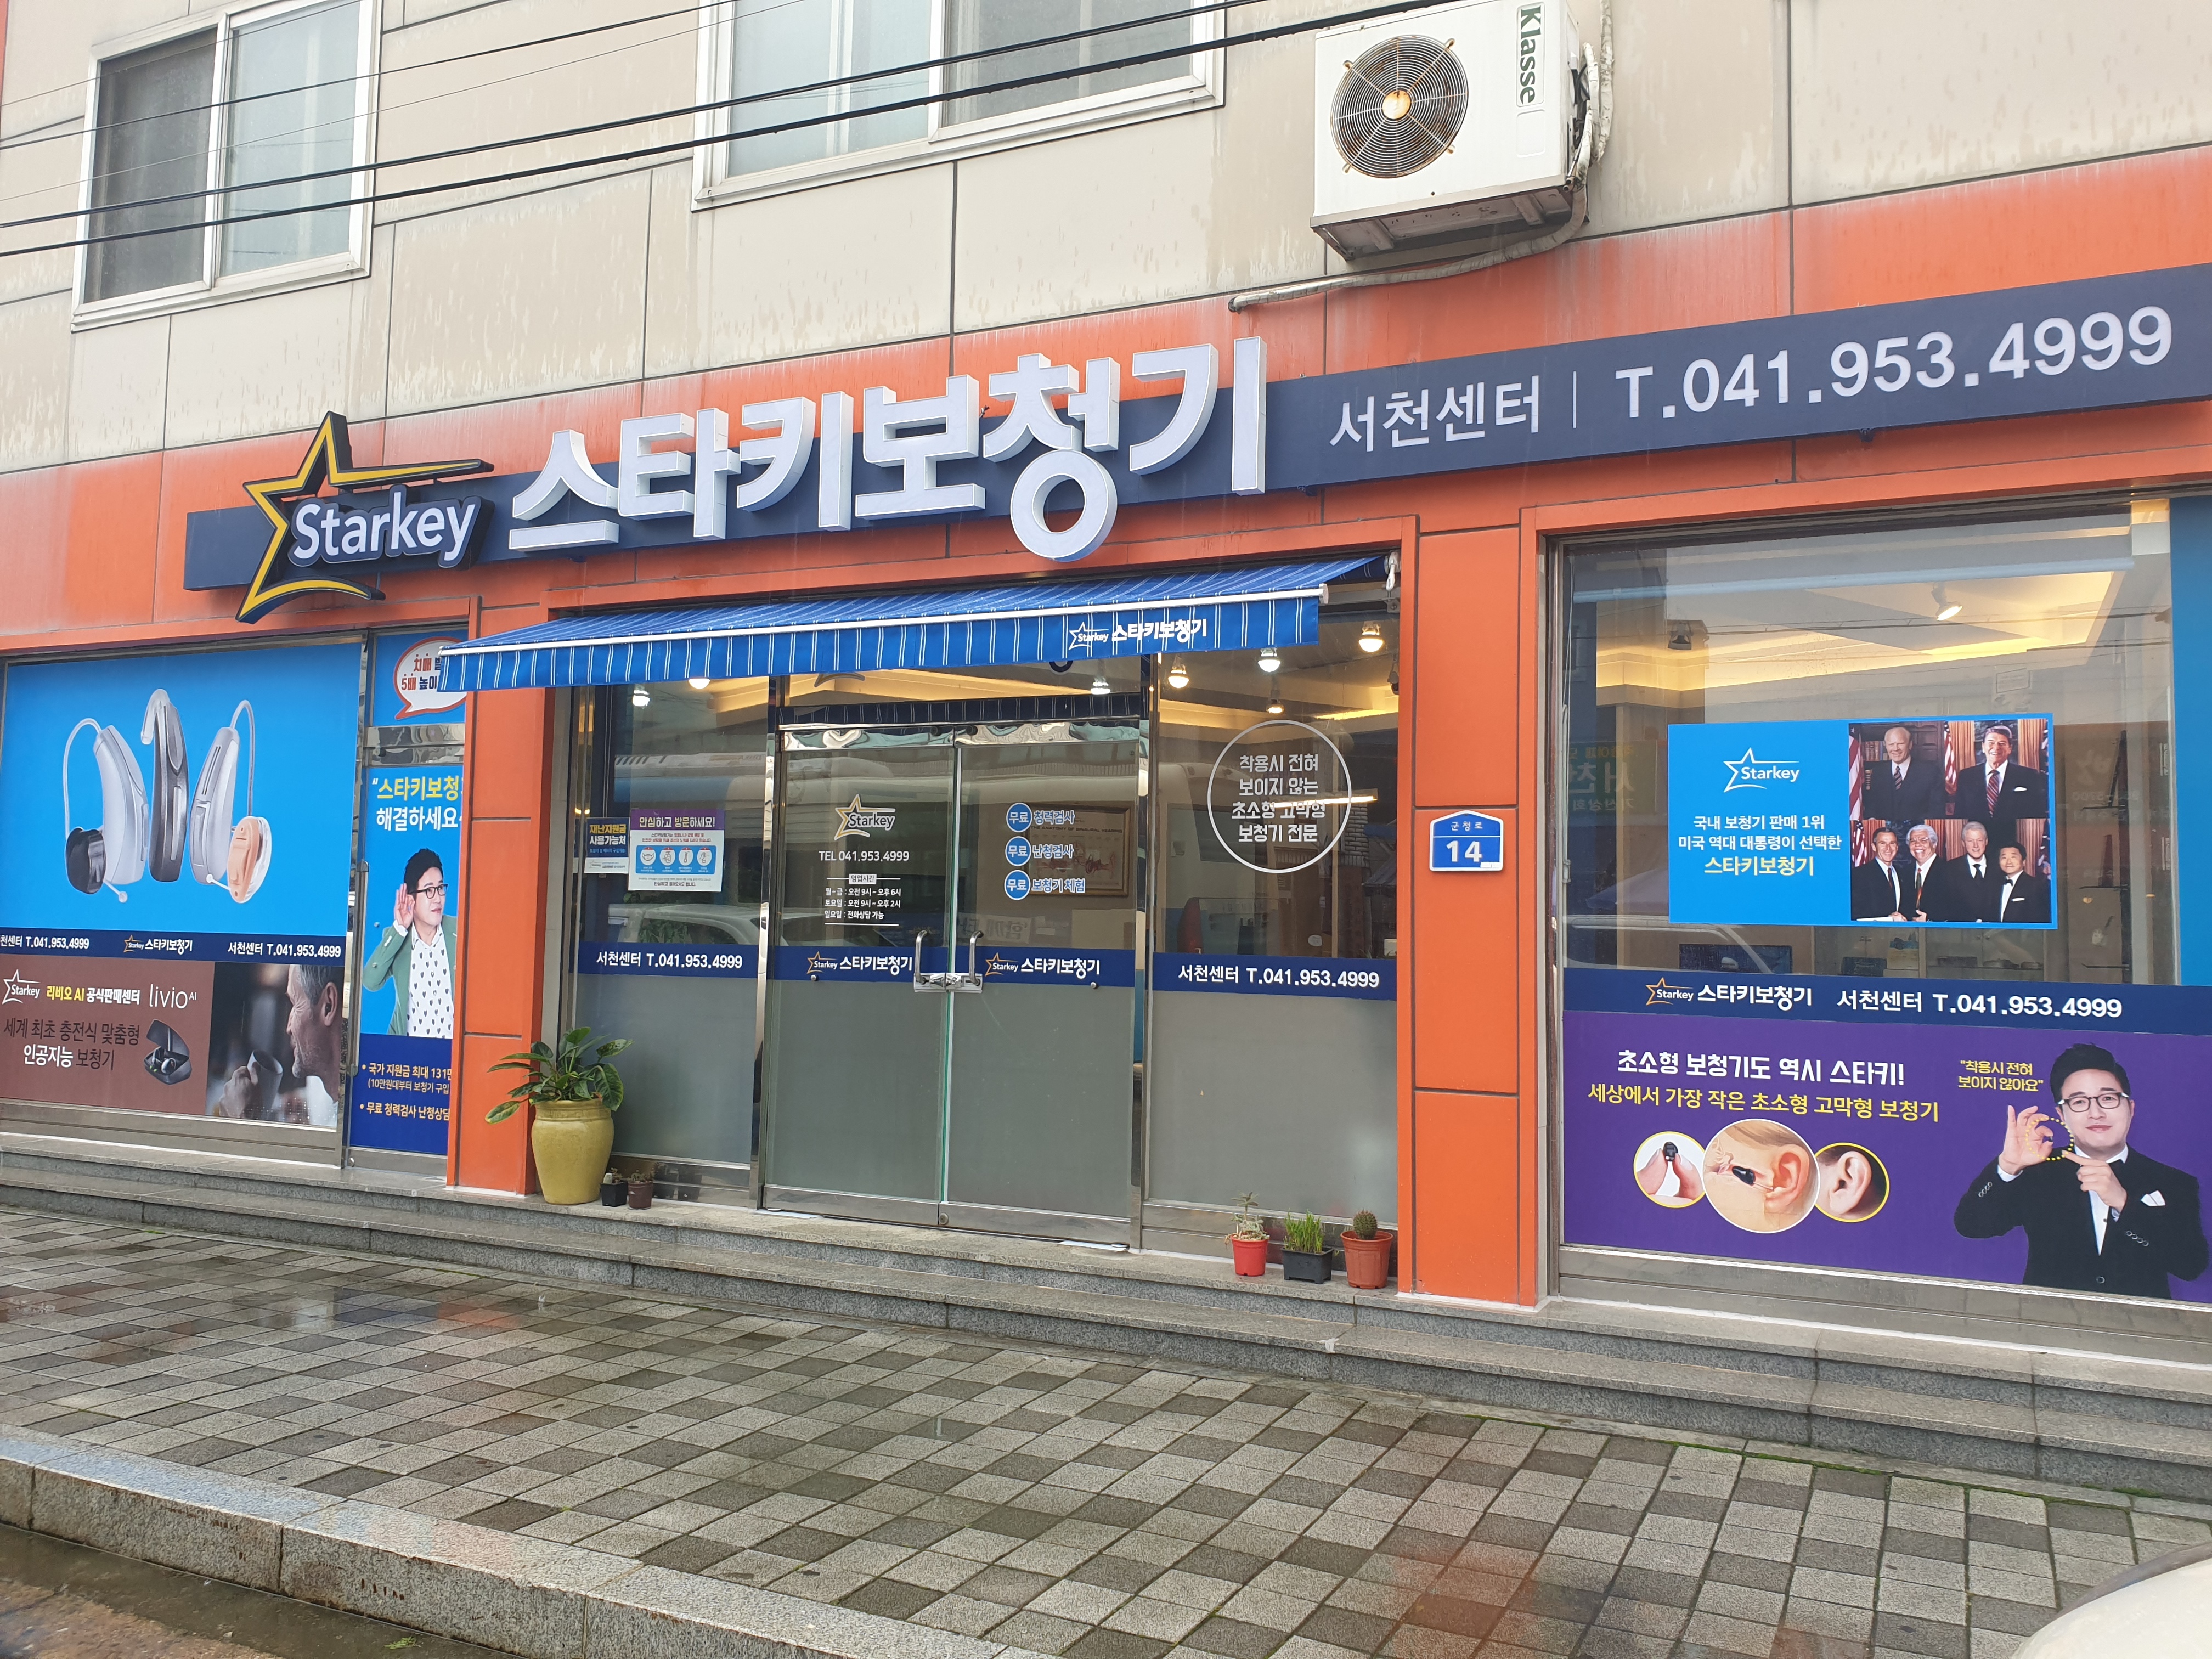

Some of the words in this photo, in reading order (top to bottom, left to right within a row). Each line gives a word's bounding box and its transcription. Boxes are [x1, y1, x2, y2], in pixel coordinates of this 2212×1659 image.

[1520, 6, 1542, 105] Klasse
[292, 485, 478, 568] Starkey
[509, 336, 1267, 562] 스타키보청기
[1329, 375, 1539, 452] 서천센터
[1616, 306, 2172, 419] T.041.953.4999
[1077, 632, 1109, 642] Starkey
[1111, 619, 1207, 643] 스타키보청기
[414, 657, 432, 672] 치매
[401, 677, 416, 691] 5배
[1240, 754, 1284, 772] 착용시
[1289, 753, 1318, 771] 전혀
[1741, 765, 1800, 782] Starkey
[1239, 778, 1283, 795] 보이지
[1289, 777, 1318, 795] 않는
[1008, 811, 1029, 824] 무료
[1034, 810, 1075, 825] 청력검사
[1232, 801, 1275, 819] 초소형
[589, 823, 627, 834] 재난지원금
[639, 816, 672, 828] 안심하고
[674, 816, 715, 828] 방문하세요!
[849, 813, 895, 830] Starkey
[1693, 816, 1720, 830] 국내
[1724, 815, 1765, 830] 보청기
[1769, 815, 1797, 830] 판매
[1802, 815, 1825, 830] 1위
[589, 835, 627, 845] 사용가능처
[1238, 824, 1282, 842] 보청기
[1288, 825, 1318, 842] 전문
[1678, 836, 1705, 850] 미국
[1708, 836, 1736, 850] 역대
[1740, 835, 1795, 850] 대통령이
[1799, 834, 1842, 850] 선택한
[819, 851, 837, 861] TEL
[839, 851, 910, 862] 041.953.4999
[1007, 845, 1028, 858] 무료
[1032, 844, 1074, 859] 난청검사
[1446, 840, 1482, 862] 14
[1704, 856, 1814, 876] 스타키보청기
[851, 874, 875, 883] 영업시간
[1007, 879, 1027, 891] 무료
[1031, 878, 1063, 893] 보청기
[1064, 878, 1086, 893] 체험
[848, 888, 860, 896] 오전
[861, 888, 871, 896] 9시
[891, 888, 901, 897] 6시
[825, 899, 843, 907] 토요일
[847, 899, 860, 907] 오전
[861, 900, 871, 908] 9시
[877, 900, 890, 908] 오후
[890, 899, 901, 908] 2시
[825, 911, 842, 919] 일요일
[847, 911, 871, 919] 전화상담
[872, 911, 884, 919] 가능
[26, 936, 90, 950] T.041.953.4999
[128, 942, 145, 950] Starkey
[145, 938, 193, 955] 스타키보청기
[228, 941, 263, 956] 서천센터
[267, 944, 342, 958] T.041.953.4999
[596, 951, 641, 967] 서천센터
[646, 953, 743, 969] T.041.953.4999
[814, 960, 838, 970] Starkey
[839, 955, 912, 975] 스타키보청기
[992, 962, 1019, 972] Starkey
[1020, 958, 1100, 979] 스타키보청기
[1178, 964, 1239, 983] 서천센터
[1246, 967, 1380, 988] T.041.953.4999
[10, 984, 41, 999] Starkey
[46, 985, 72, 1001] 리비오
[74, 988, 85, 1002] AI
[86, 987, 140, 1005] 공식판매센터
[1656, 989, 1694, 1001] Starkey
[1697, 985, 1812, 1011] 스타키보청기
[1837, 990, 1922, 1013] 서천센터
[1932, 994, 2123, 1018] T.041.953.4999
[3, 1017, 28, 1039] 세계
[31, 1018, 57, 1040] 최초
[59, 1020, 98, 1043] 충전식
[101, 1023, 140, 1046] 맞춤형
[24, 1043, 74, 1068] 인공지능
[76, 1048, 115, 1071] 보청기
[368, 1063, 385, 1076] 국가
[386, 1064, 411, 1078] 지원금
[412, 1065, 429, 1079] 최대
[1618, 1049, 1679, 1075] 초소형
[1686, 1053, 1771, 1080] 보청기도
[1779, 1058, 1821, 1082] 역시
[1830, 1060, 1905, 1086] 스타키!
[2006, 1062, 2033, 1076] 전혀
[368, 1077, 412, 1092] (10만원대부터
[413, 1082, 435, 1093] 보청기
[435, 1084, 449, 1095] 구입
[1958, 1075, 1997, 1090] 보이지
[1588, 1083, 1660, 1107] 세상에서
[1666, 1088, 1703, 1109] 가장
[1707, 1090, 1746, 1111] 작은
[1751, 1092, 1808, 1115] 초소형
[1814, 1097, 1872, 1119] 고막형
[1878, 1099, 1939, 1122] 보청기
[366, 1102, 383, 1114] 무료
[385, 1103, 417, 1119] 청력검사
[418, 1106, 451, 1121] 난청상담
